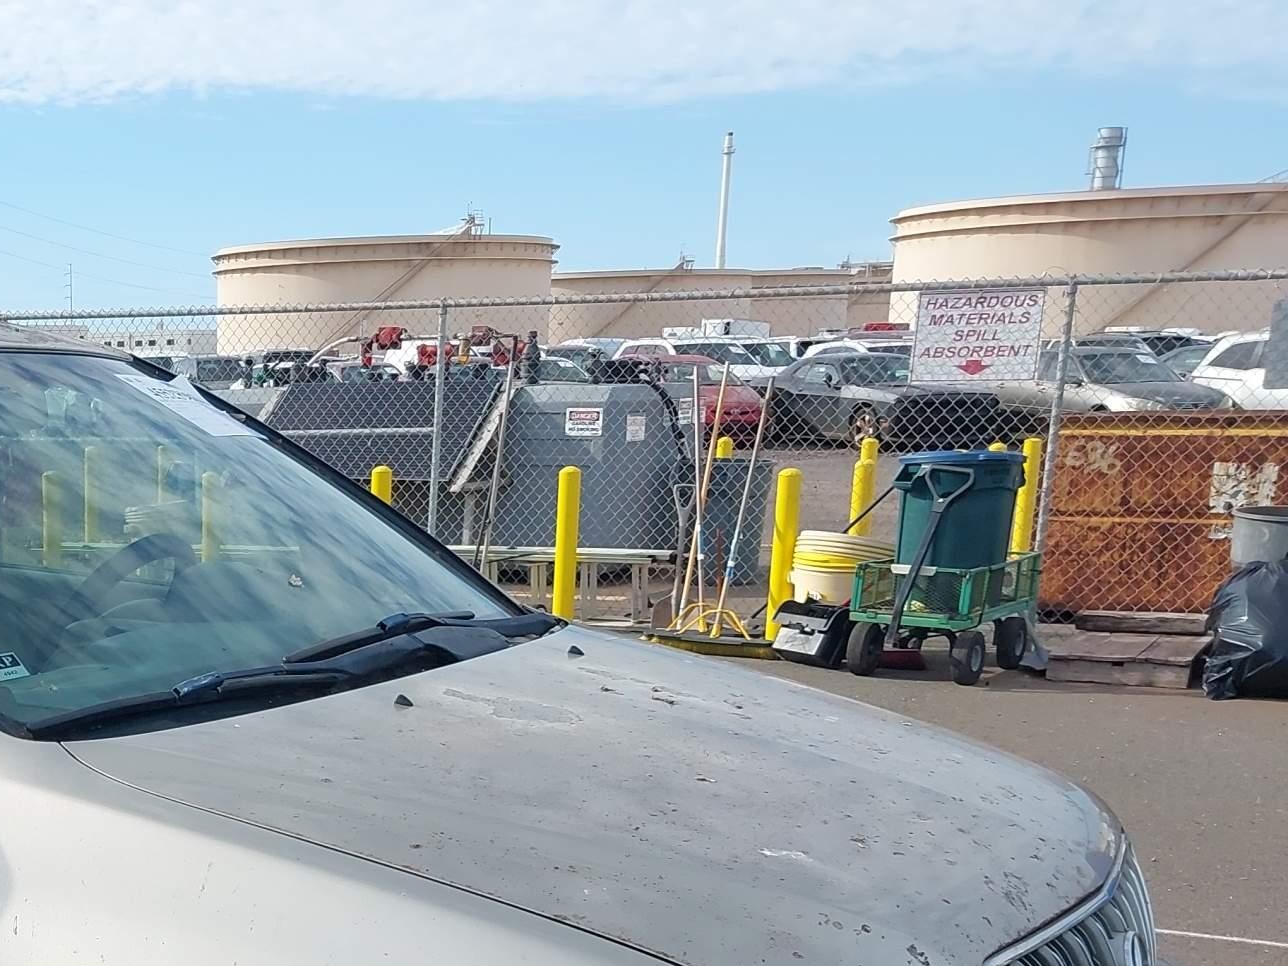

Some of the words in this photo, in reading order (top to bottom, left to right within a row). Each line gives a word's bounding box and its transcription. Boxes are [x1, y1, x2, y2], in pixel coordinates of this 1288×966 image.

[924, 295, 1039, 310] HAZARDOUS
[928, 311, 1031, 326] MATERIALS
[953, 328, 1001, 342] SPILL
[919, 344, 1033, 359] ABSORBENT
